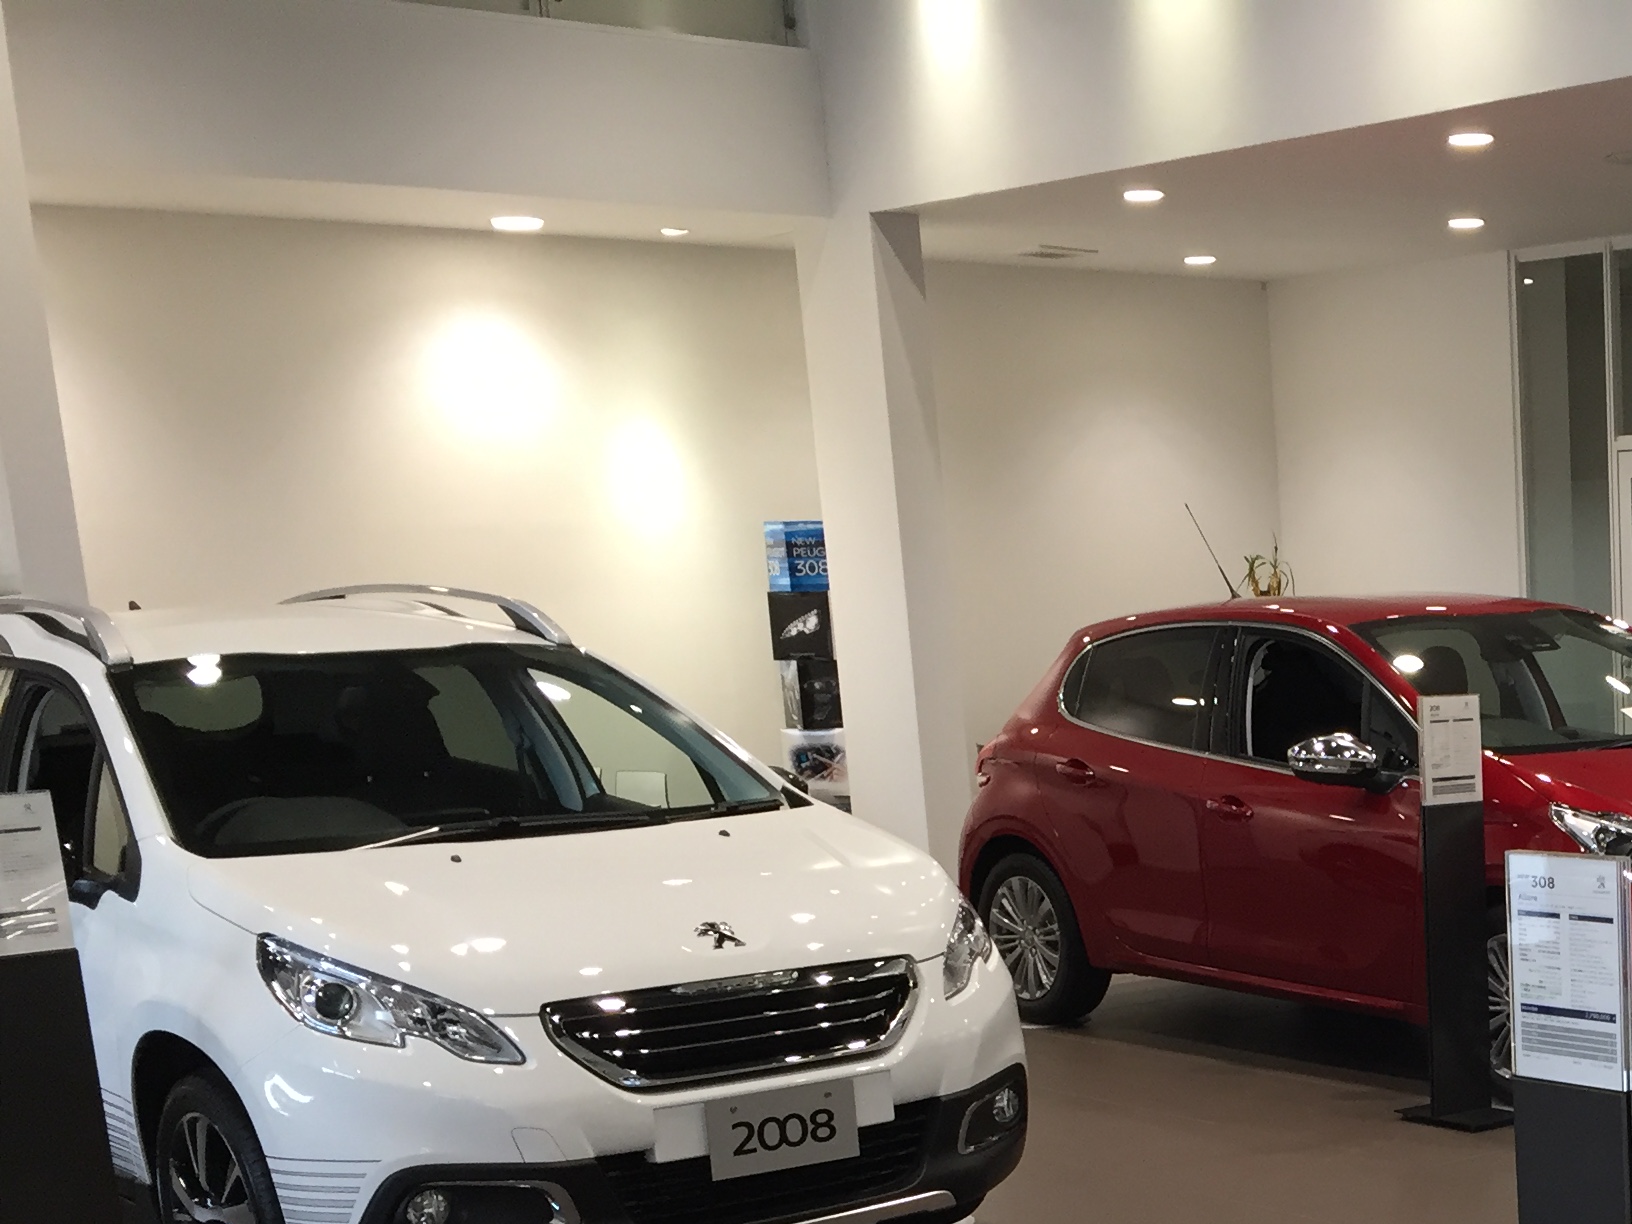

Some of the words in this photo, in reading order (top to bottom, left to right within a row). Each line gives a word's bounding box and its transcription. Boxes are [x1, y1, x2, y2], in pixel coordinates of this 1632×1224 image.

[791, 535, 816, 546] NEW
[1531, 875, 1555, 890] 308
[731, 1108, 838, 1157] 2008
